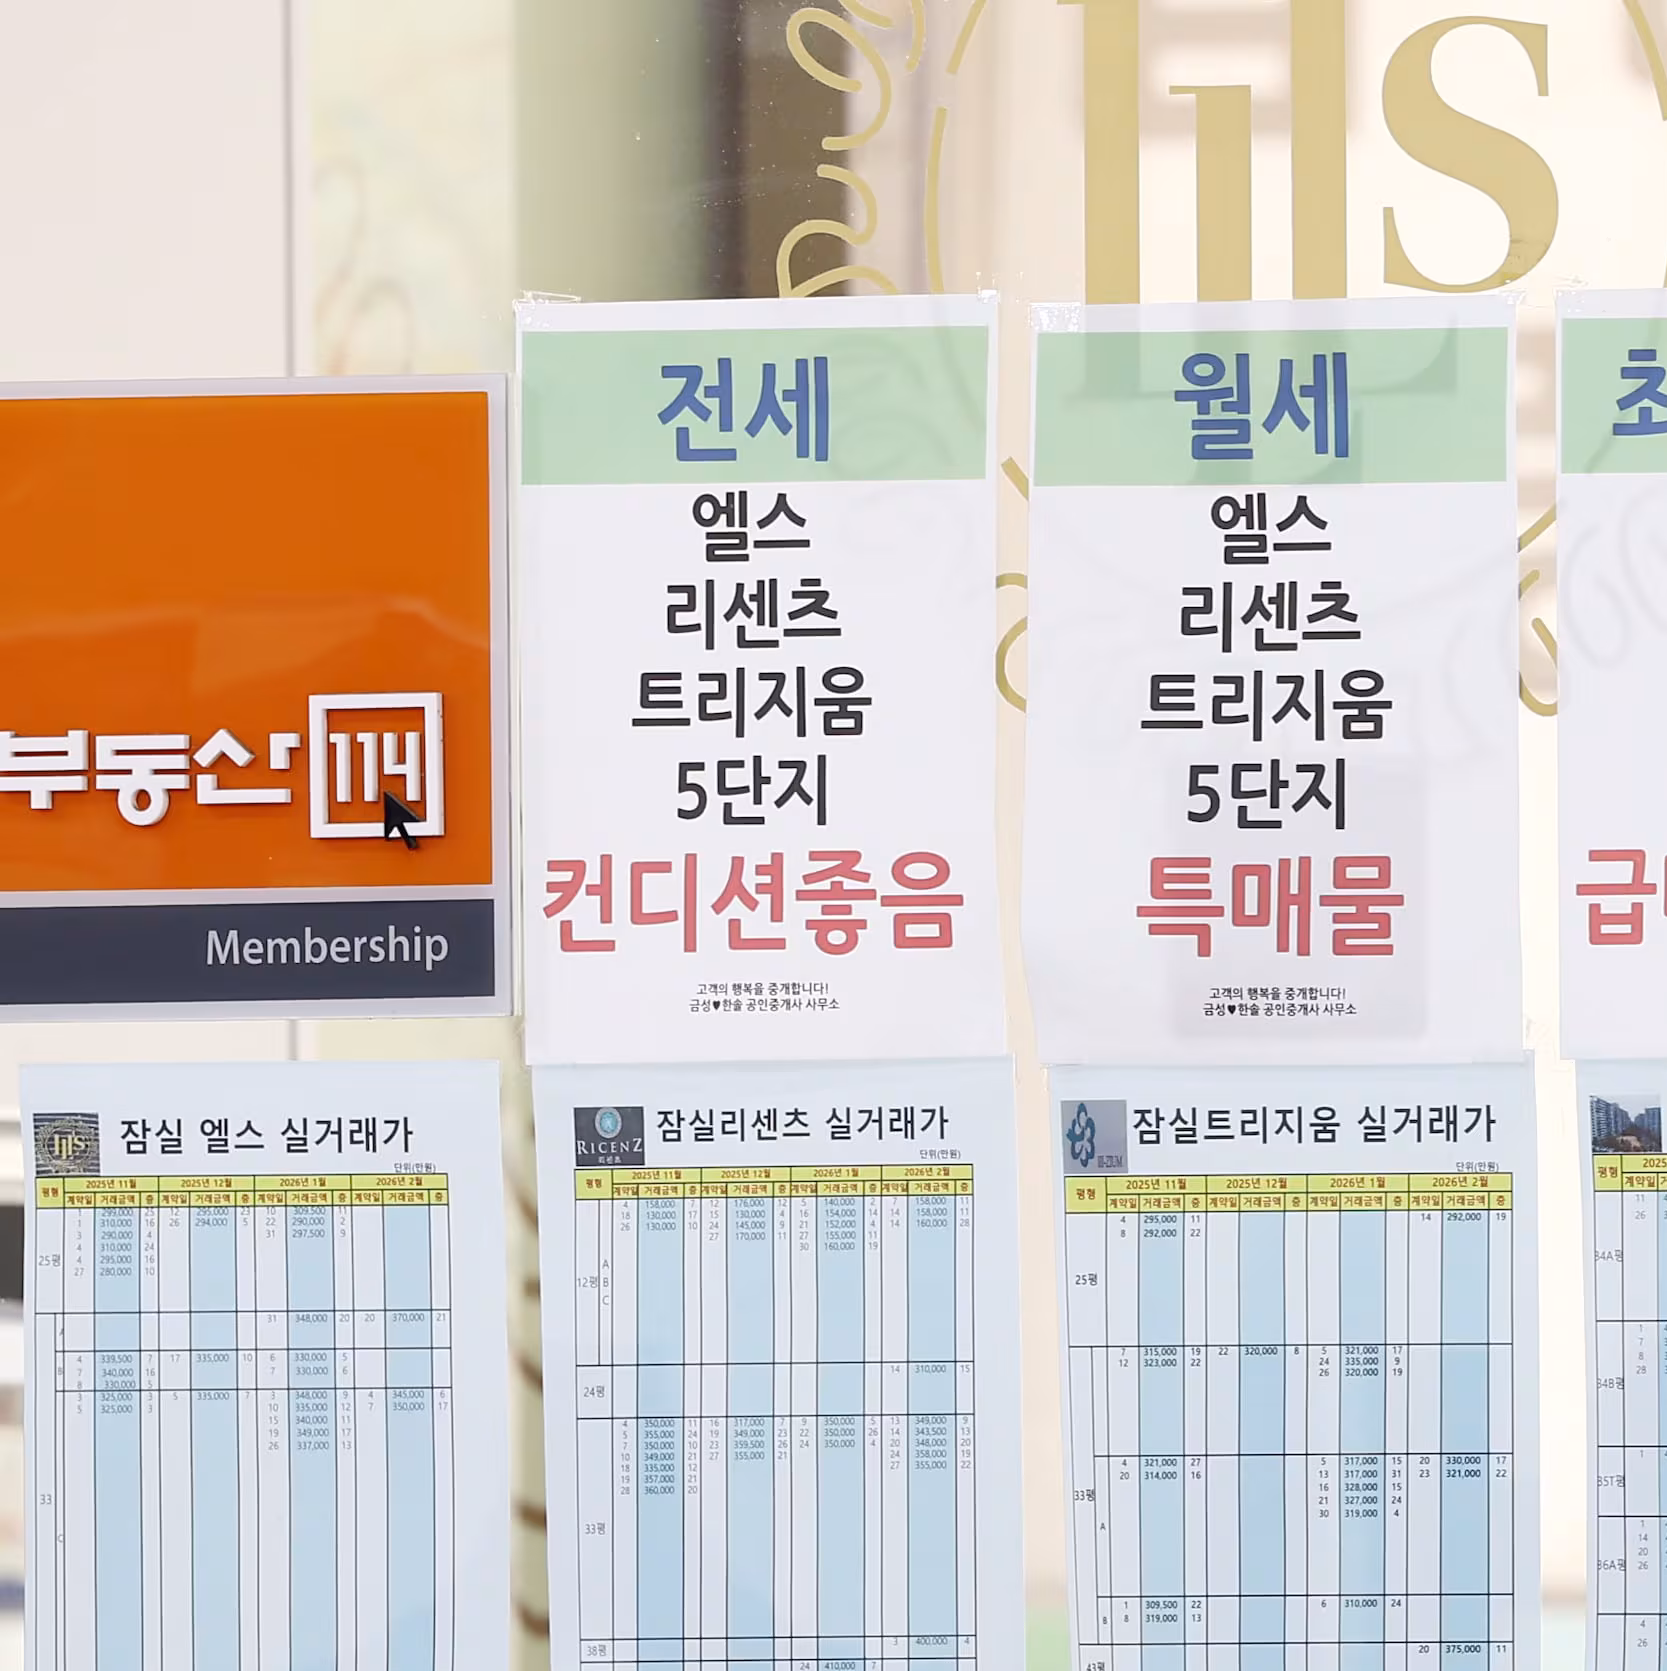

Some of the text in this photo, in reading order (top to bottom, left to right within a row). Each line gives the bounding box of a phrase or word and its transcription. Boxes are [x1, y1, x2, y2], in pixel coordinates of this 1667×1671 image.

[658, 357, 829, 461] 전세
[1175, 352, 1349, 460] 월세
[693, 491, 810, 562] 엘스
[1211, 493, 1331, 564] 엘스
[667, 579, 841, 650] 리센츠
[1181, 581, 1360, 653] 리센츠
[632, 667, 872, 738] 트리지움
[1141, 670, 1392, 741] 트리지움
[329, 729, 423, 806] 114
[678, 755, 826, 825] 5단지
[1188, 759, 1345, 829] 5단지
[543, 851, 963, 955] 컨디션좋음
[1137, 856, 1404, 957] 특매물
[207, 925, 448, 970] Membership
[697, 982, 829, 996] 고객의 행복을 중개합니다!
[746, 998, 802, 1011] 공인중개사
[805, 998, 840, 1010] 사무소
[1209, 987, 1346, 1000] 고객의 행복을 중개합니다!
[121, 1119, 182, 1154] 잠실
[200, 1118, 264, 1153] 엘스
[281, 1117, 413, 1153] 실거래가
[658, 1106, 948, 1142] 잠실리센츠 실거래가
[1133, 1105, 1496, 1144] 잠실트리지움 실거래가
